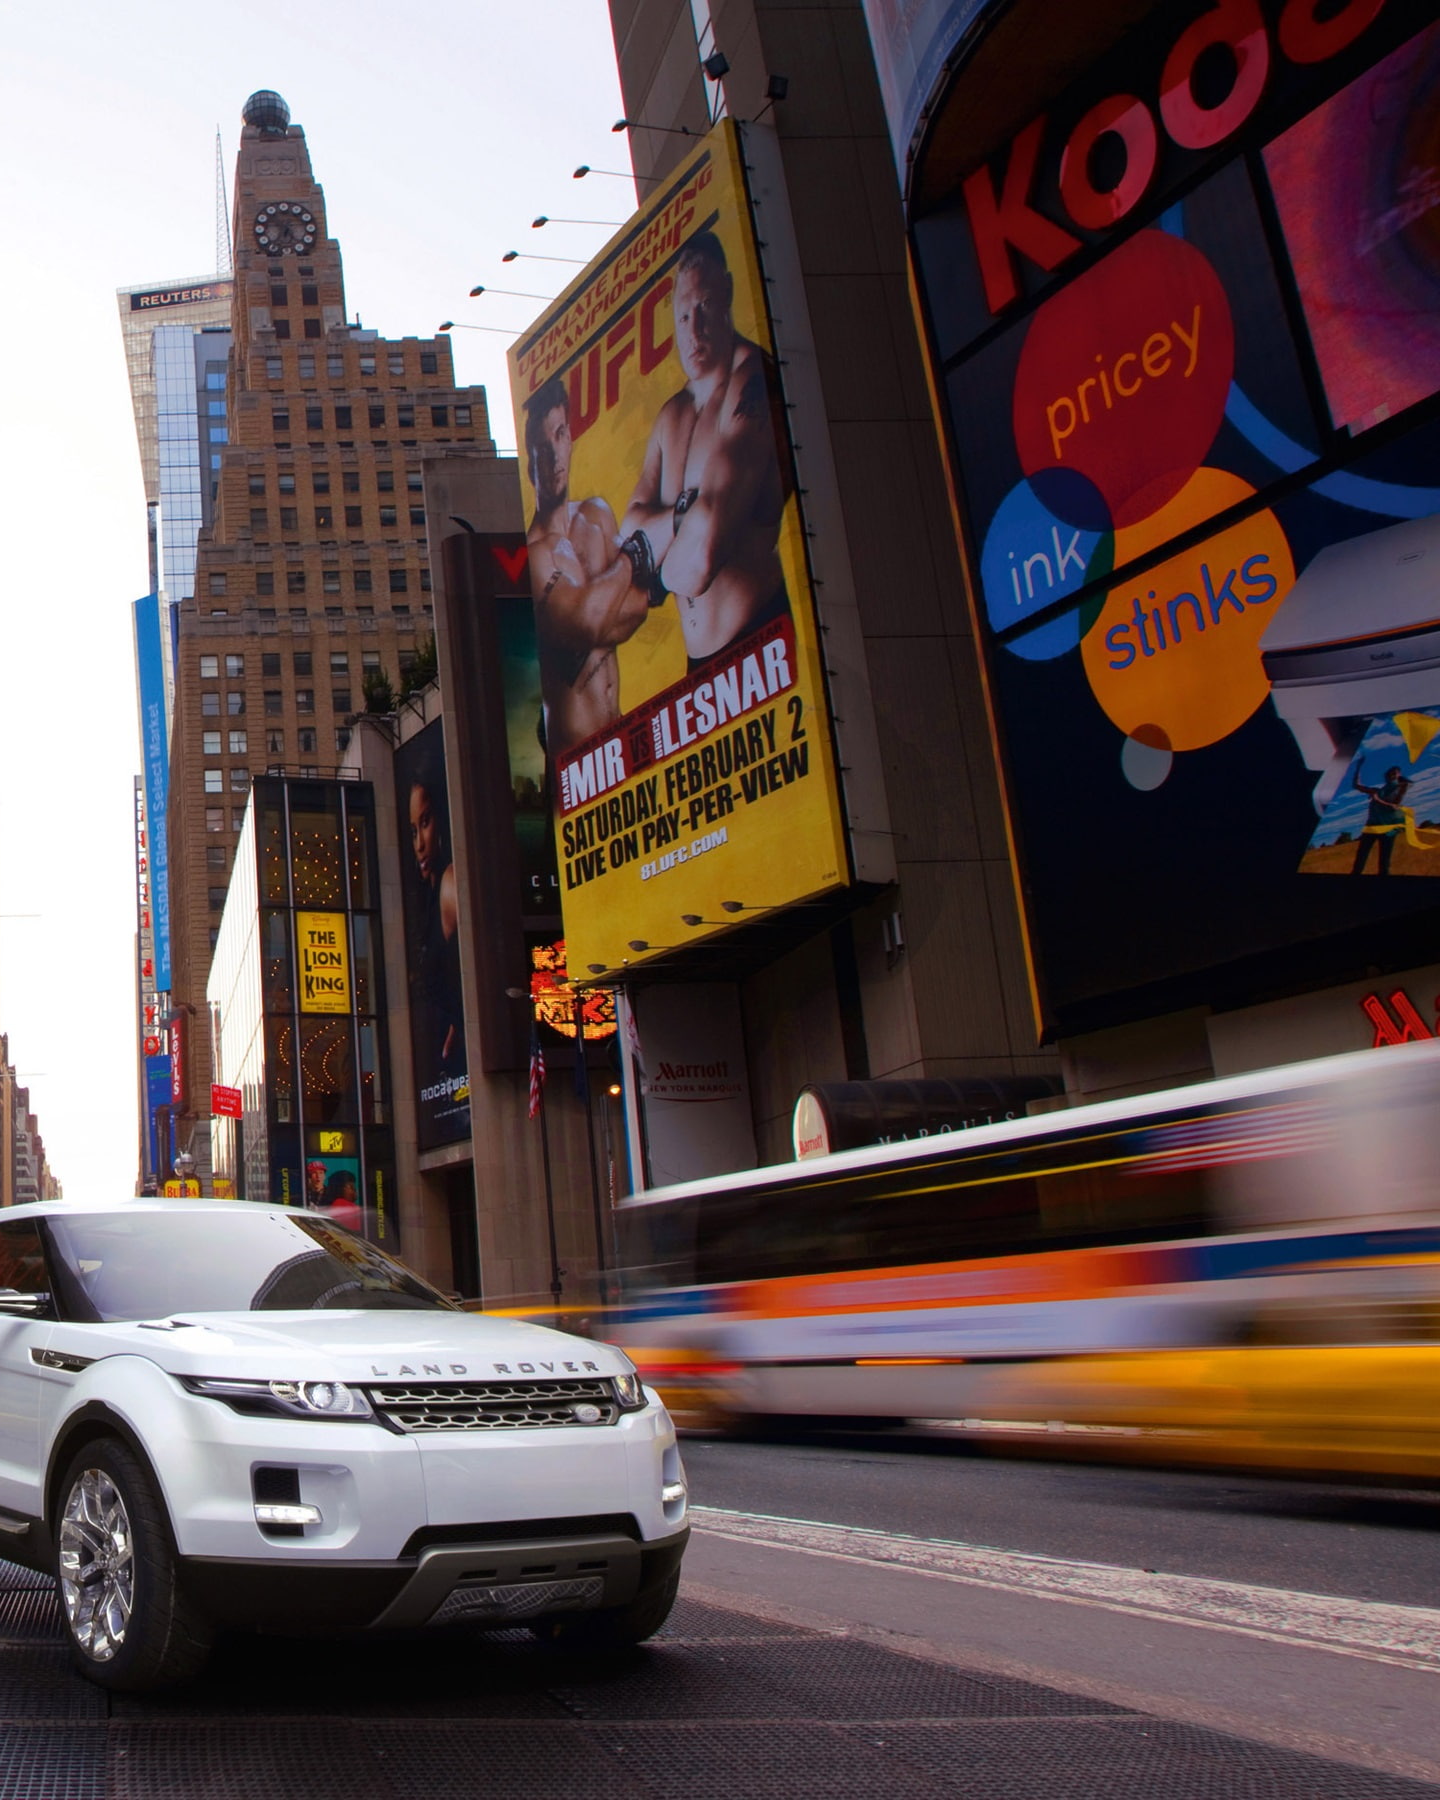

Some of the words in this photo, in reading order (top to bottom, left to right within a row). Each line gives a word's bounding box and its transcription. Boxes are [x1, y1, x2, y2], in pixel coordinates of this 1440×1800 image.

[517, 274, 608, 378] ULTIMATE
[613, 162, 713, 280] FIGHTING
[140, 287, 211, 307] REUTERS
[529, 206, 695, 394] CHAMPIONSHIP
[569, 276, 673, 442] UFC
[1046, 304, 1202, 459] pricey
[1008, 523, 1088, 606] ink
[1104, 550, 1279, 673] stinks
[660, 637, 793, 757] LESNAR
[149, 703, 160, 759] Market
[652, 714, 662, 760] BROCK
[152, 772, 164, 813] Select
[561, 768, 572, 811] FRANK
[563, 775, 664, 859] SATURDAY,
[665, 708, 776, 807] FEBRUARY
[787, 695, 806, 742] 2
[568, 737, 627, 808] MIR
[565, 846, 606, 890] LIVE
[610, 830, 639, 868] ON
[642, 741, 809, 854] PAY-PER-VIEW
[156, 821, 167, 868] Global
[159, 873, 169, 938] NASDAQ
[162, 943, 170, 973] The
[308, 930, 336, 945] THE
[304, 949, 343, 973] LION
[305, 975, 345, 999] KING
[655, 1060, 729, 1082] Marriott
[670, 1083, 696, 1093] YORK
[698, 1083, 743, 1094] MARQUIS
[799, 1133, 824, 1157] Marriott
[877, 1111, 1017, 1147] MARQUIS
[371, 1363, 468, 1377] LAND
[492, 1360, 600, 1374] ROVER
